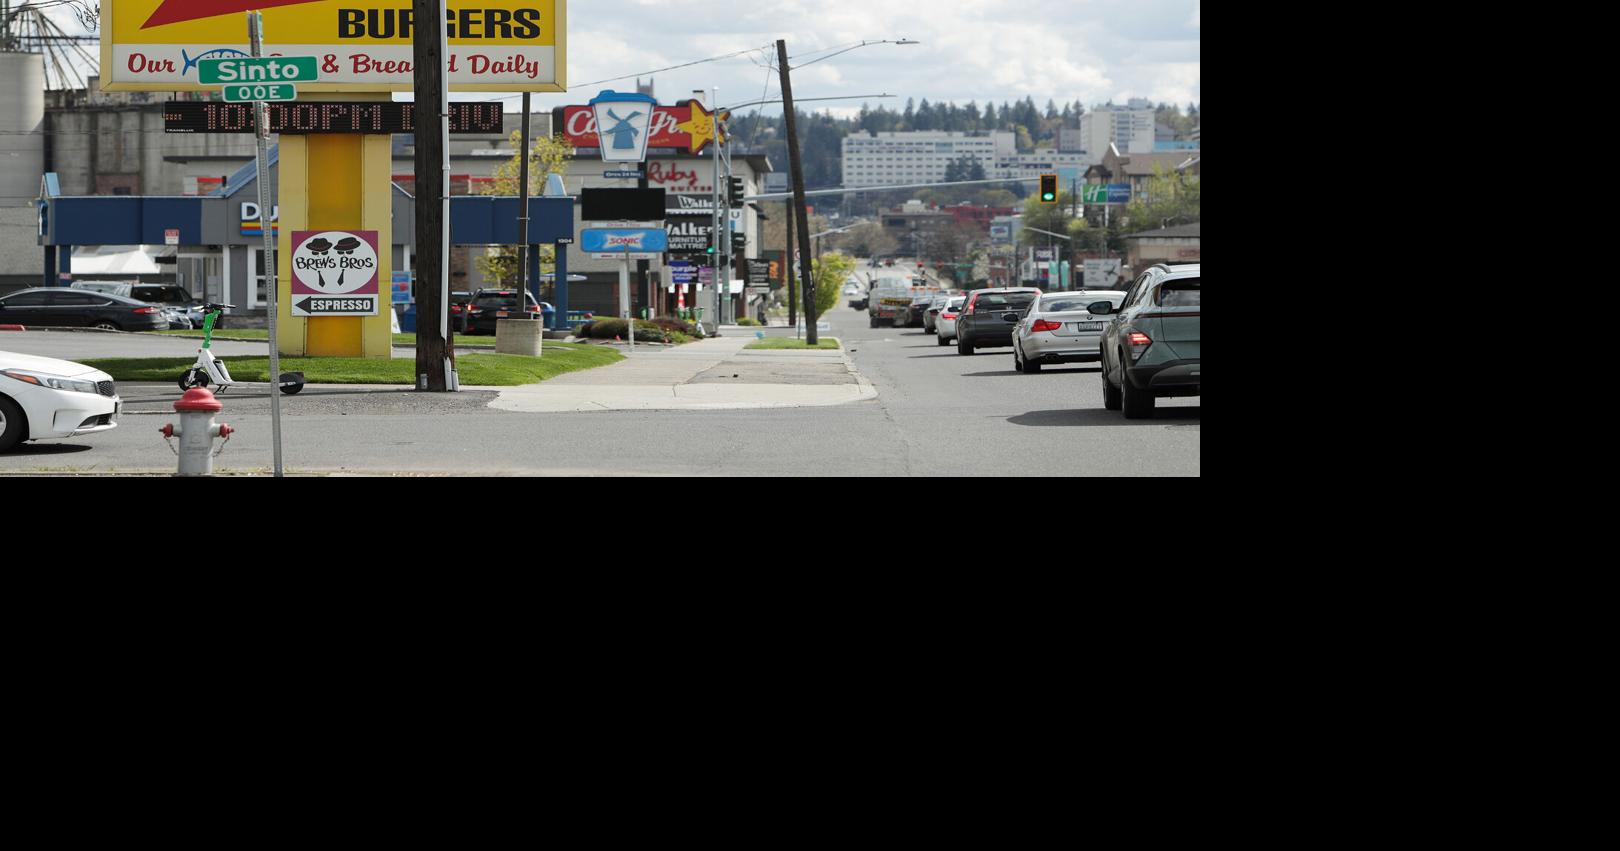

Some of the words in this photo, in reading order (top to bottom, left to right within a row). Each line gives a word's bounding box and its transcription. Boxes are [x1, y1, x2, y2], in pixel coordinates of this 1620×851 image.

[127, 52, 176, 74] Our
[321, 53, 340, 73] &
[348, 53, 459, 74] Bread
[466, 54, 539, 79] Daily
[217, 60, 300, 81] Sinto
[647, 162, 698, 186] Ruby
[609, 237, 640, 245] SONIC
[295, 256, 337, 271] BREWS
[339, 256, 374, 270] BROS
[310, 299, 371, 311] ESPRESSO
